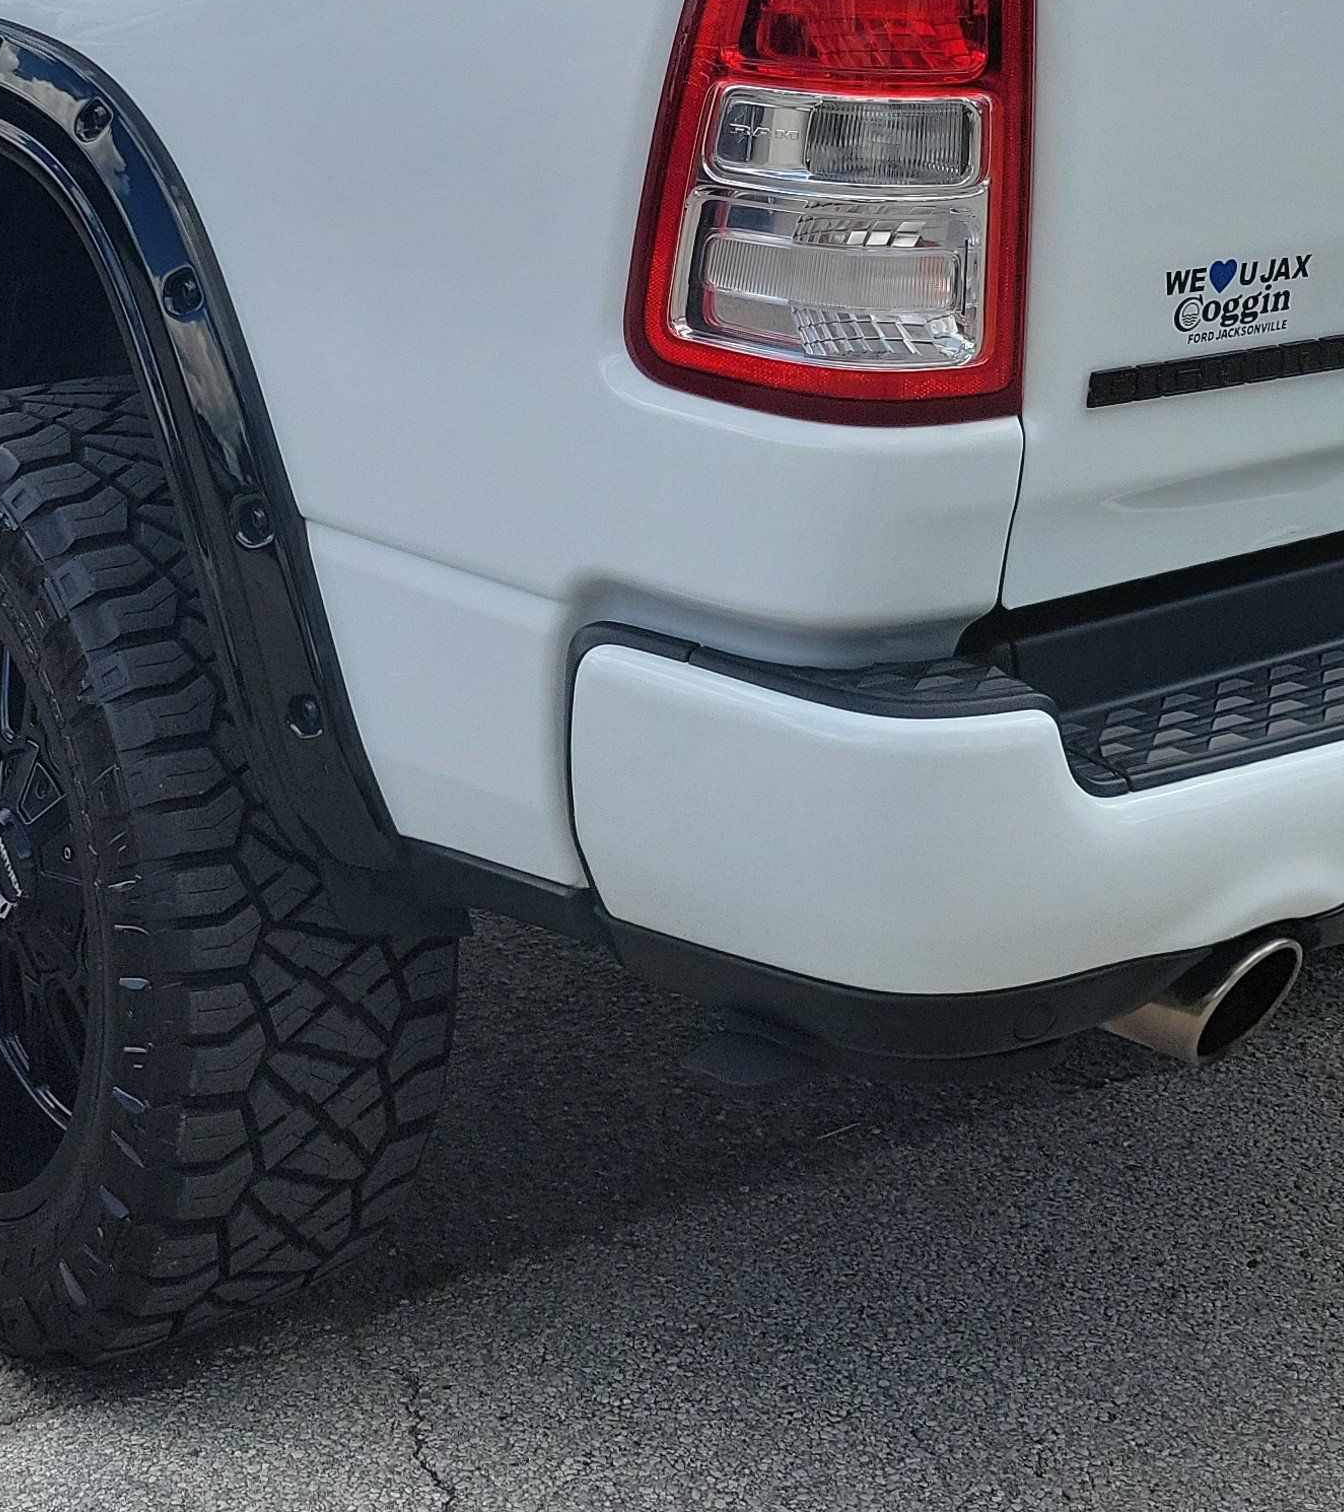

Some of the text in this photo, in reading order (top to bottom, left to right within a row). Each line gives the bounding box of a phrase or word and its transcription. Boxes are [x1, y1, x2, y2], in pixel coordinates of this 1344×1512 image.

[1165, 254, 1312, 295] WE U JAX
[1174, 284, 1290, 332] Coggin
[1187, 319, 1288, 344] FORD JACKSONVILLE
